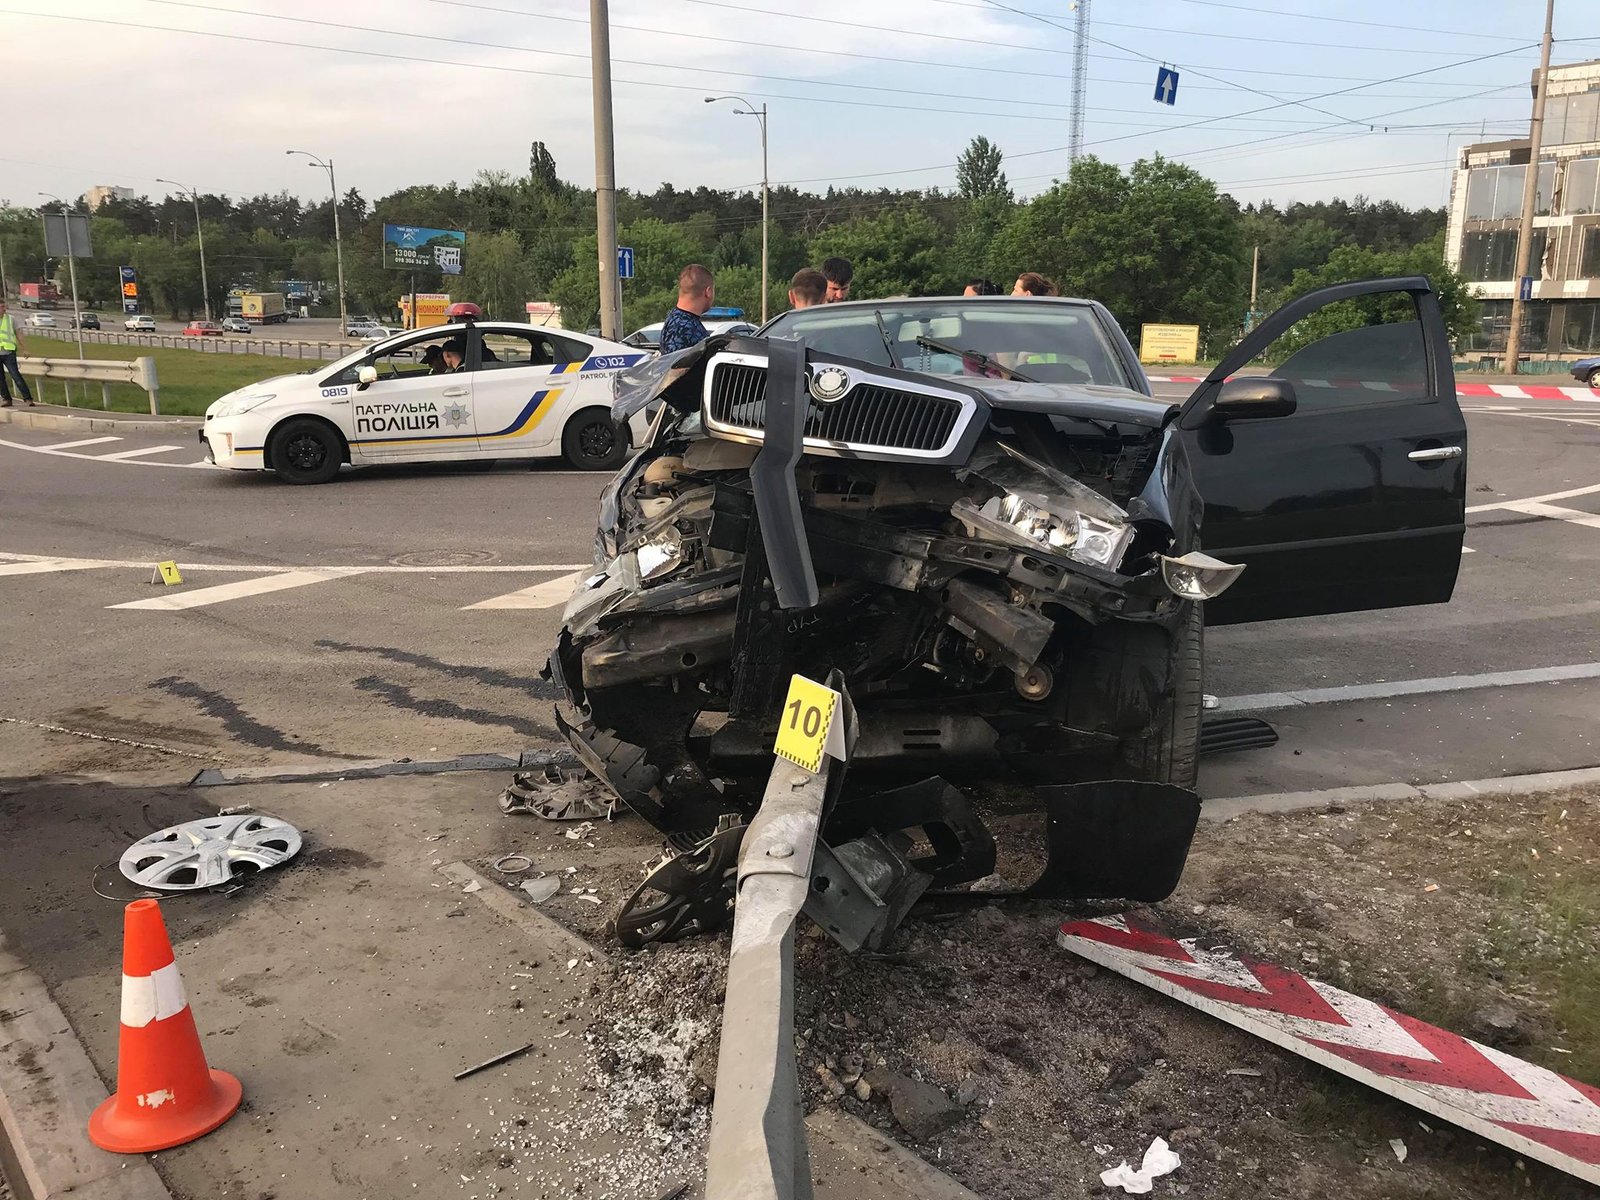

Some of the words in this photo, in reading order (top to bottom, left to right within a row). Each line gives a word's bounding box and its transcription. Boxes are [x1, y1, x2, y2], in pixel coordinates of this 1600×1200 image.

[608, 357, 625, 366] 102
[322, 387, 348, 398] 0819
[356, 402, 438, 416] ПАТРУЛЬНА
[358, 414, 440, 433] ПОЛІЦІЯ
[165, 566, 172, 576] 7
[788, 698, 822, 738] 10
